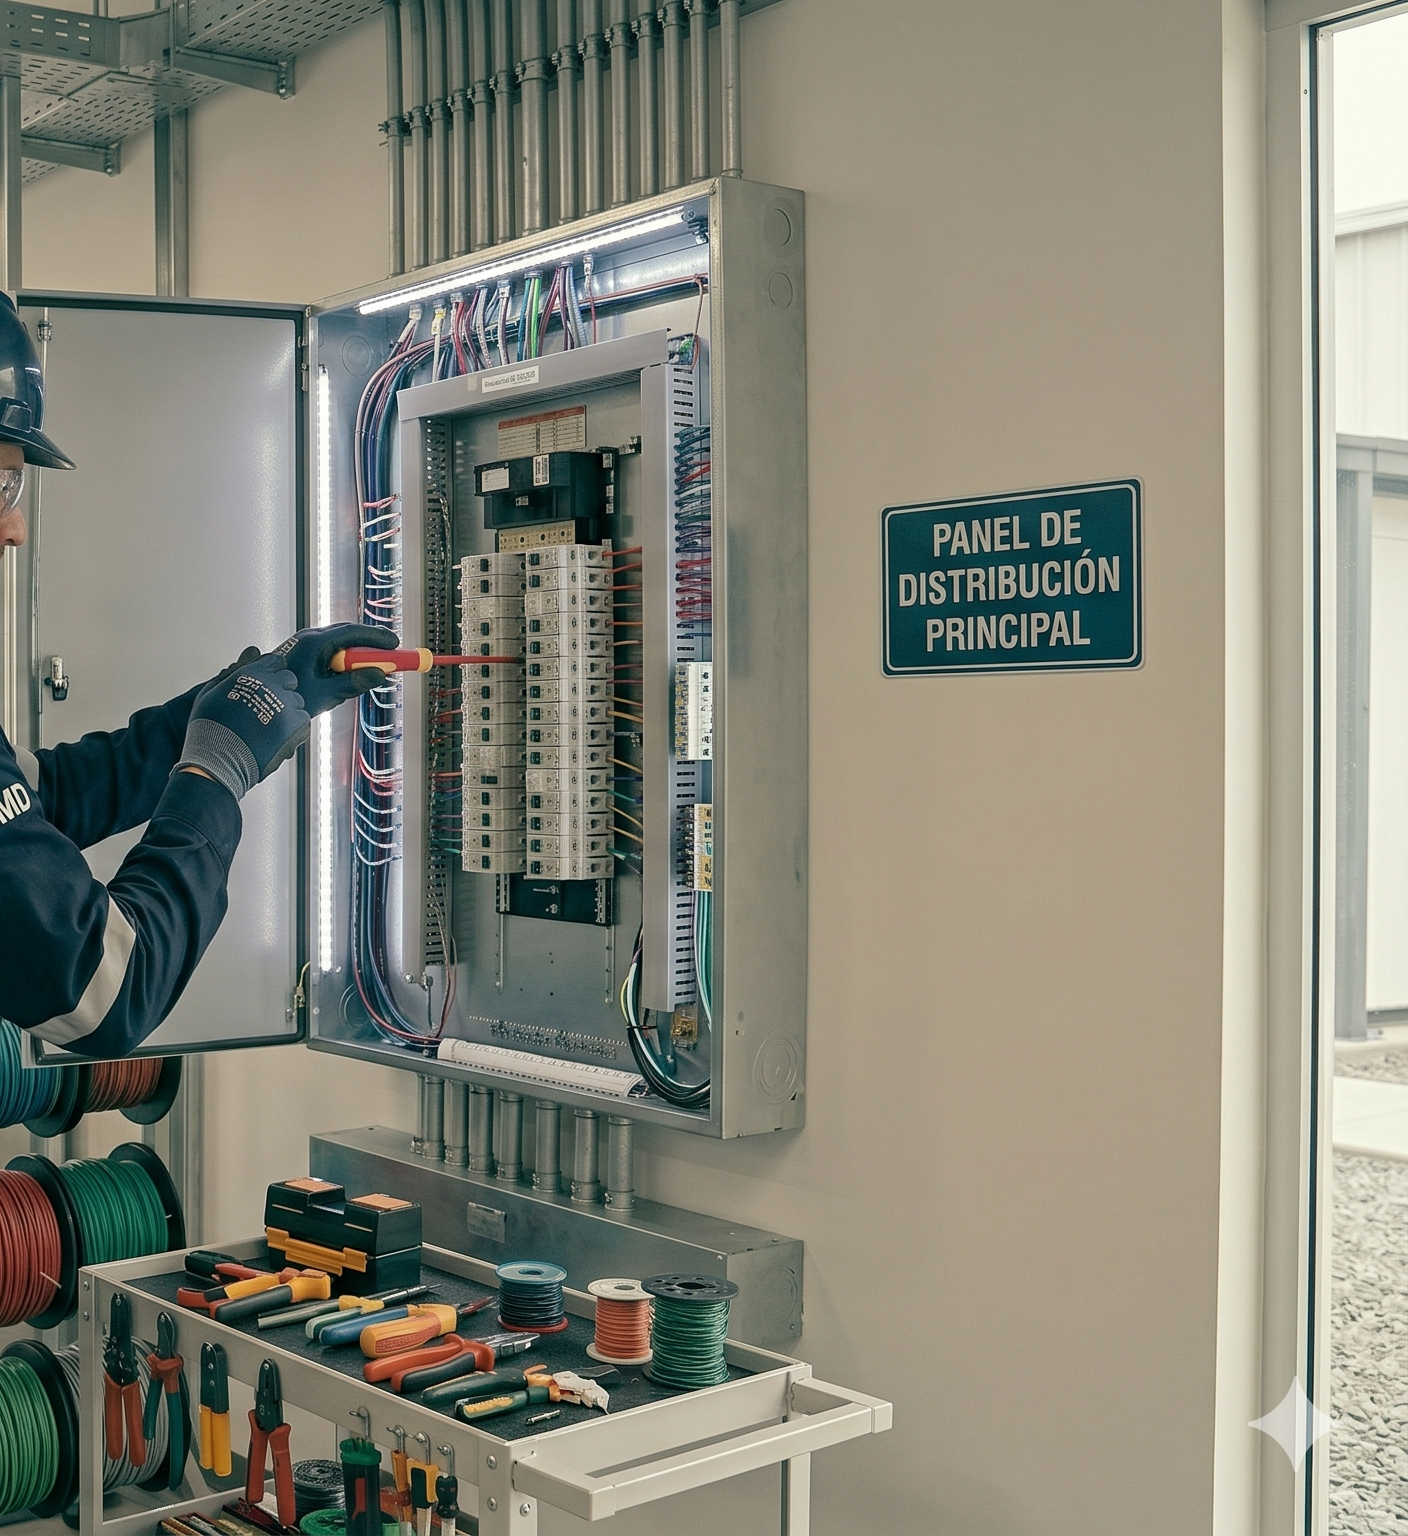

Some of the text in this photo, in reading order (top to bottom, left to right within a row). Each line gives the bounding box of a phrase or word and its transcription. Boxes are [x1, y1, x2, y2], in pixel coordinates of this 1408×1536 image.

[933, 508, 1082, 557] PANEL DE
[898, 548, 1121, 607] DISTRIBUCIÓN
[926, 610, 1091, 652] PRINCIPAL
